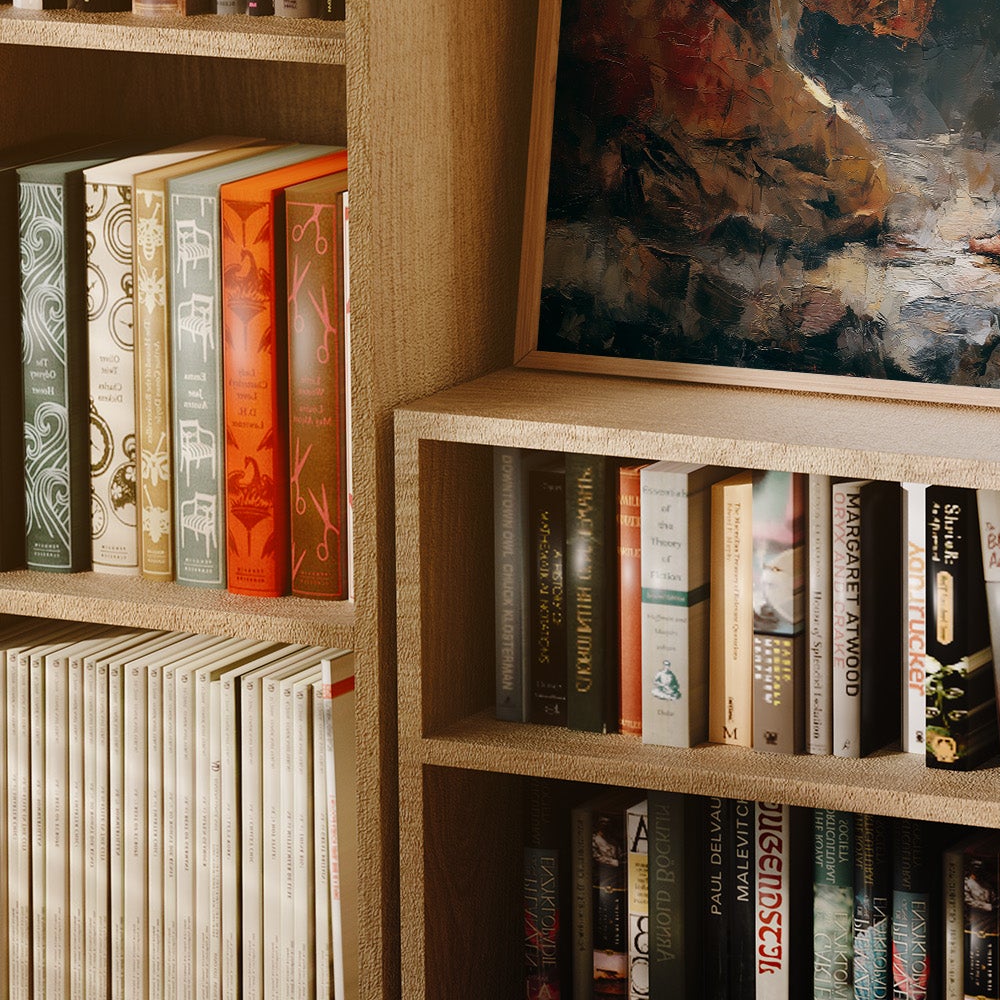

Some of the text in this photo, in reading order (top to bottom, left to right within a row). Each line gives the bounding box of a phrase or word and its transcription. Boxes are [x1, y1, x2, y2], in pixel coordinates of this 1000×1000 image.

[502, 455, 514, 690] DOWNTOWN OWL CHUCK KLOSTERMAN
[834, 492, 846, 669] ORYX AND CRAKE
[846, 493, 860, 698] MARGARET ATWOOD
[710, 797, 722, 915] PAUL DELVAU
